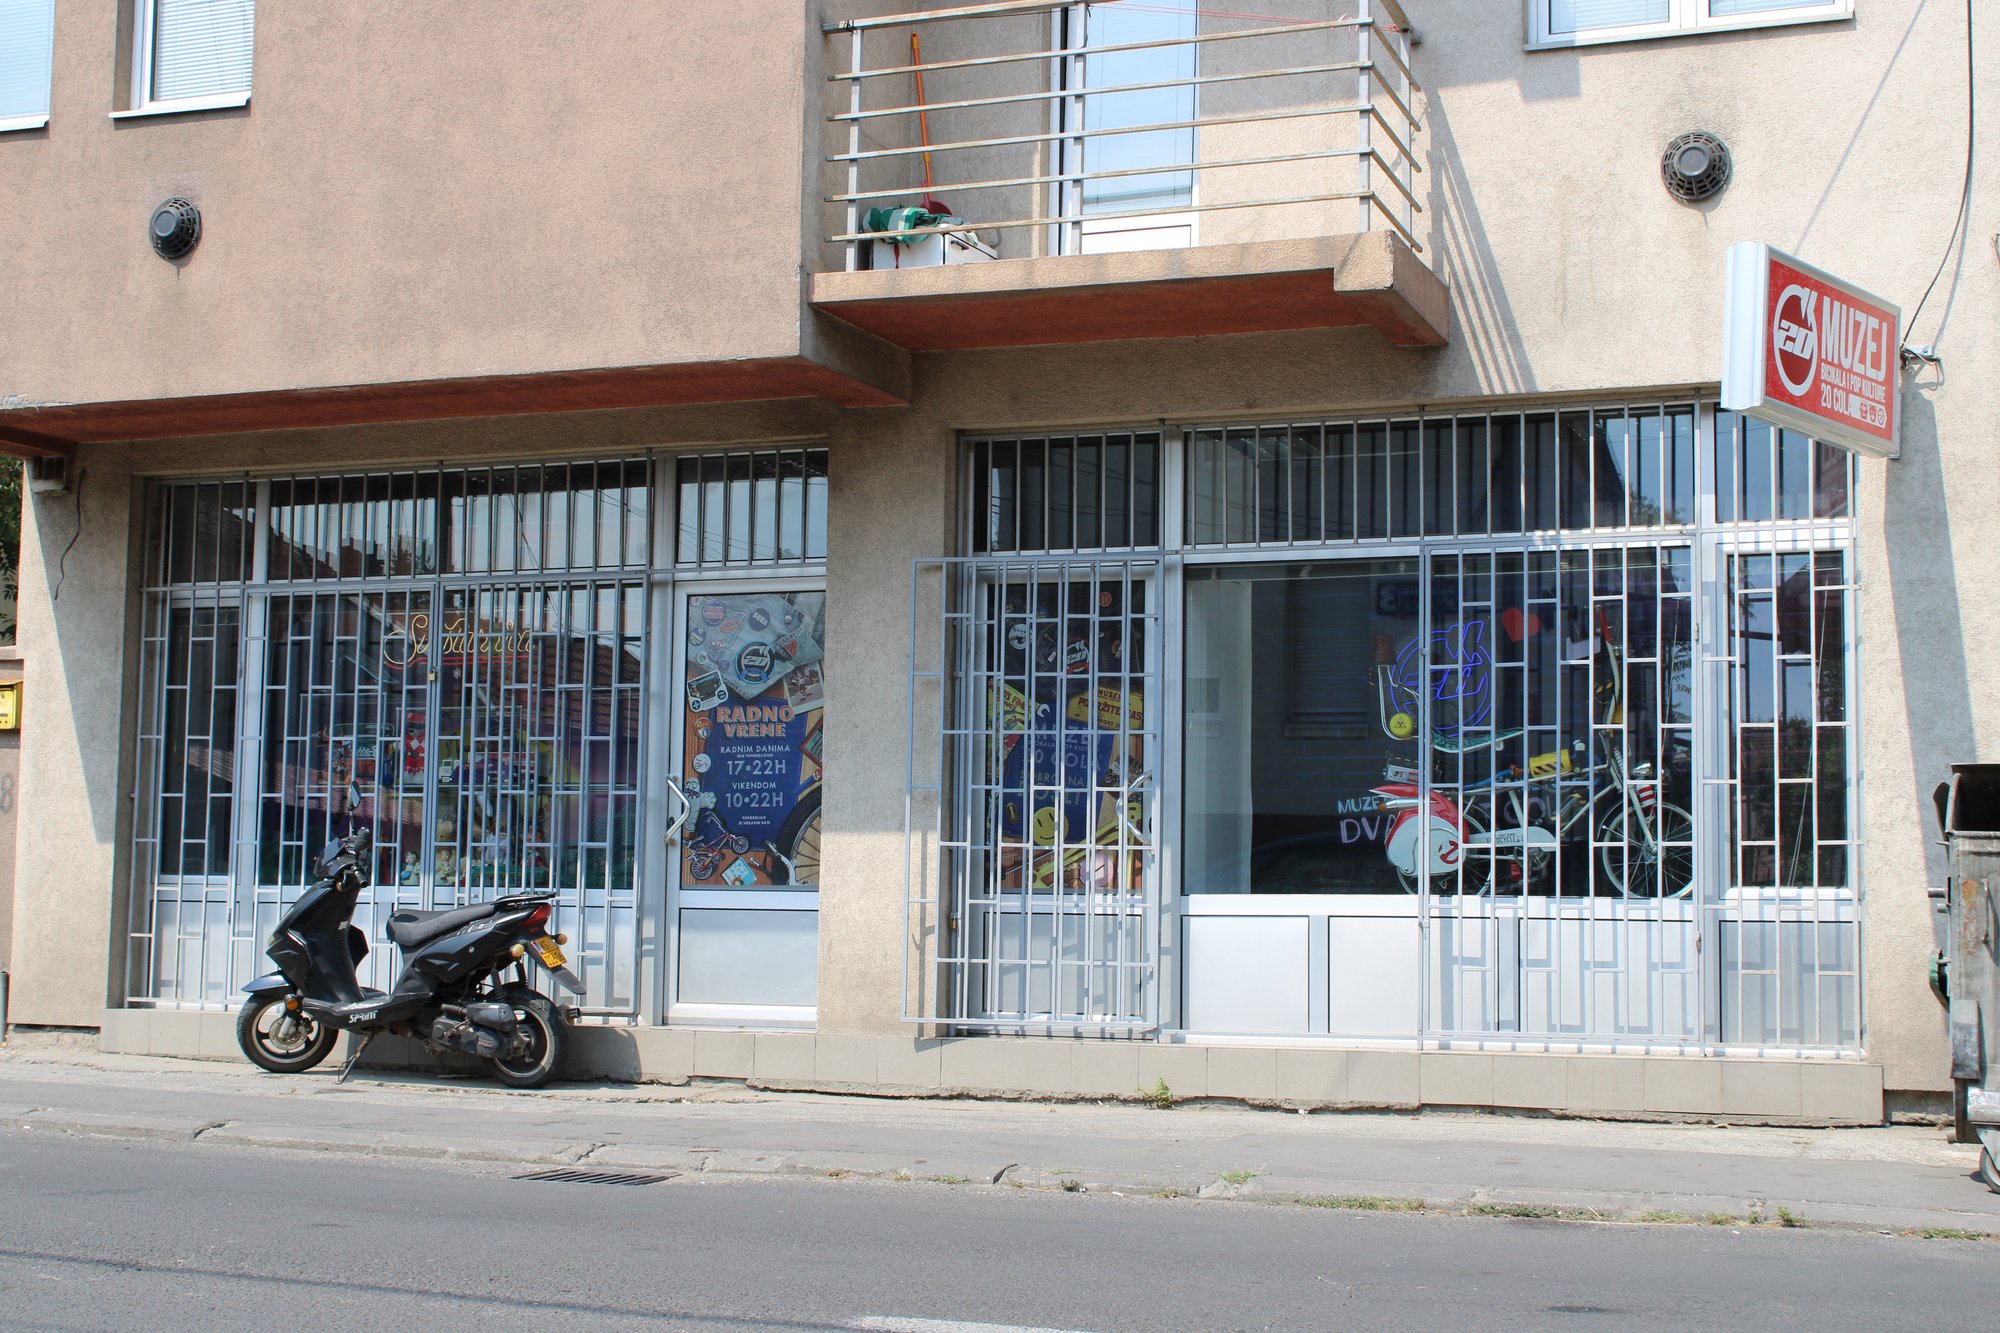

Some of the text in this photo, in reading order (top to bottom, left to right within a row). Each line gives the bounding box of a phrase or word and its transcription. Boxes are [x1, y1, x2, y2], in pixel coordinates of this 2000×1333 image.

[1820, 295, 1887, 382] MUZEJ
[1821, 382, 1831, 409] 20
[1850, 373, 1861, 394] POP
[1861, 378, 1886, 403] KULTURE
[716, 705, 795, 723] RADNO
[723, 722, 786, 738] VREME
[720, 744, 790, 754] RADNIM DANIMA
[732, 781, 776, 790] VIKENDOM
[1337, 796, 1379, 814] MUZE
